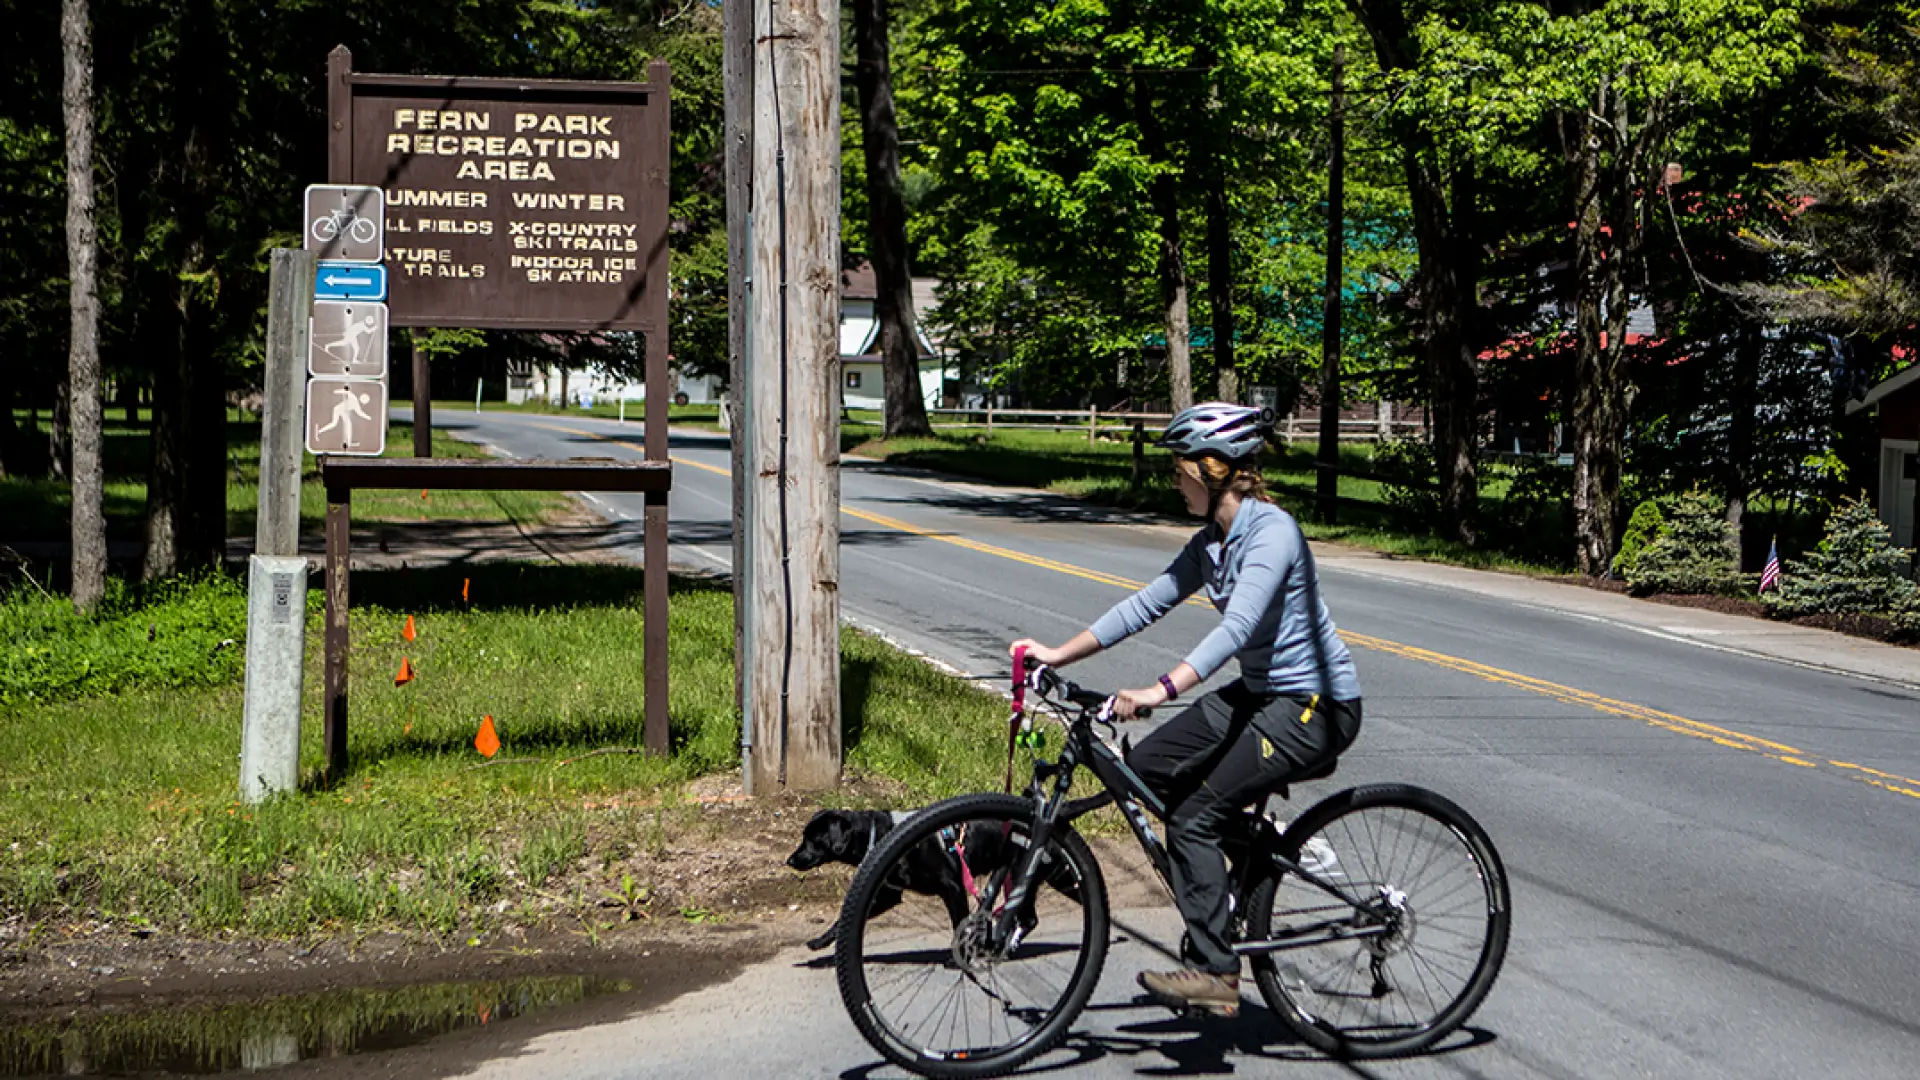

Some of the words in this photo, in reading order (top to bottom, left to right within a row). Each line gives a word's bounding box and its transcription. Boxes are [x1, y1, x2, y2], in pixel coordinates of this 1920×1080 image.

[395, 109, 489, 130] FERN
[515, 114, 611, 135] PARK
[387, 133, 619, 159] RECREATION
[457, 161, 555, 180] AREA
[386, 189, 487, 207] UMMER
[512, 193, 624, 211] WINTER
[419, 219, 493, 234] FIELDS
[509, 221, 636, 236] X-COUNTRY
[514, 236, 551, 249] SKI
[558, 236, 637, 251] TRAILS
[385, 248, 450, 262] TURE
[512, 255, 593, 269] INDOOR
[604, 258, 637, 270] ICE
[405, 264, 484, 277] TRAILS
[527, 269, 622, 282] SKATING
